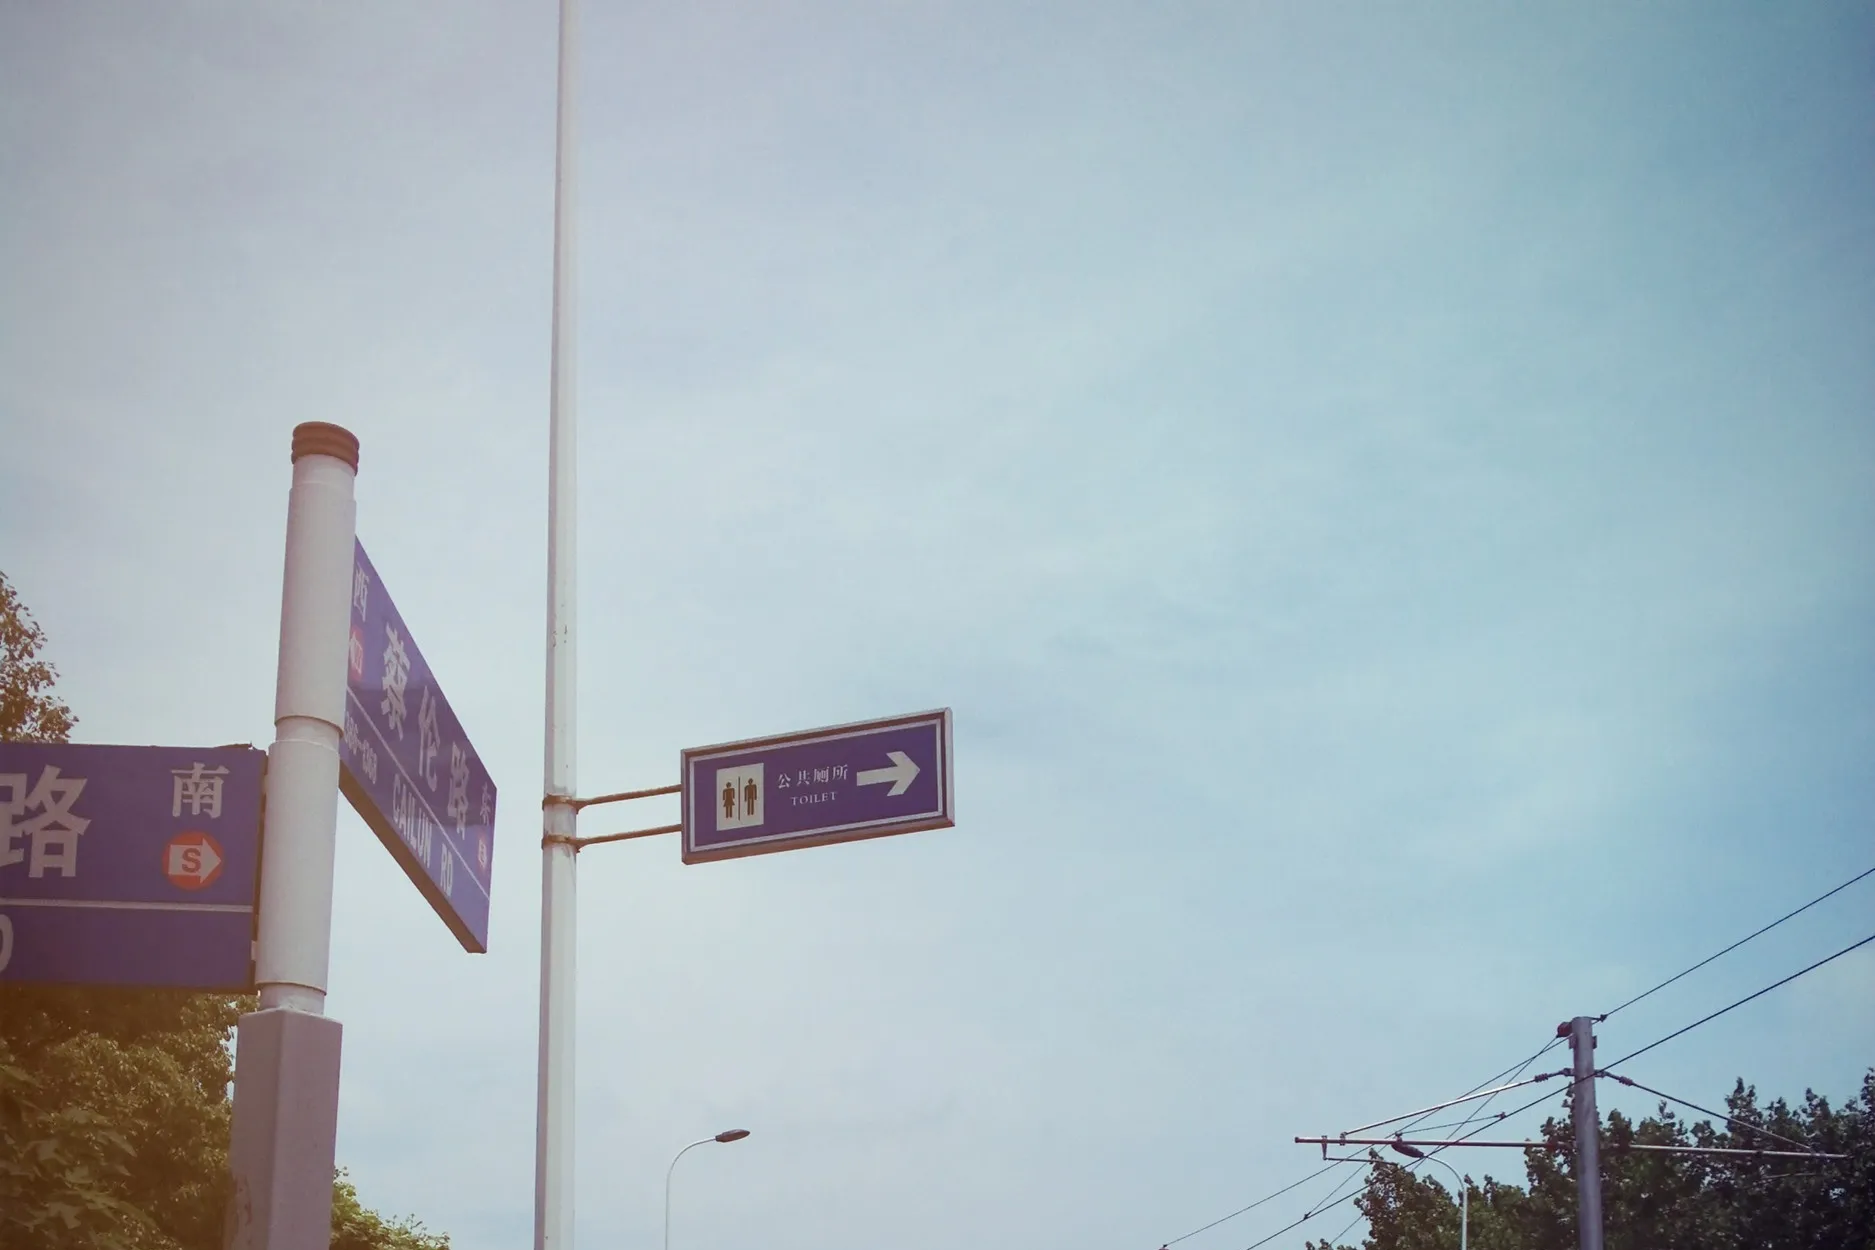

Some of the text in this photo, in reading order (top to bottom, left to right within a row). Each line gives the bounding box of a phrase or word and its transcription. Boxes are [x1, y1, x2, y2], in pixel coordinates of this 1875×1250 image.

[381, 621, 469, 841] 蔡伦路
[171, 762, 230, 819] 南
[778, 764, 848, 789] 公共厕所
[790, 791, 838, 806] TOILET
[0, 764, 92, 879] 路
[393, 773, 454, 897] CAILUN RD
[181, 848, 202, 873] S
